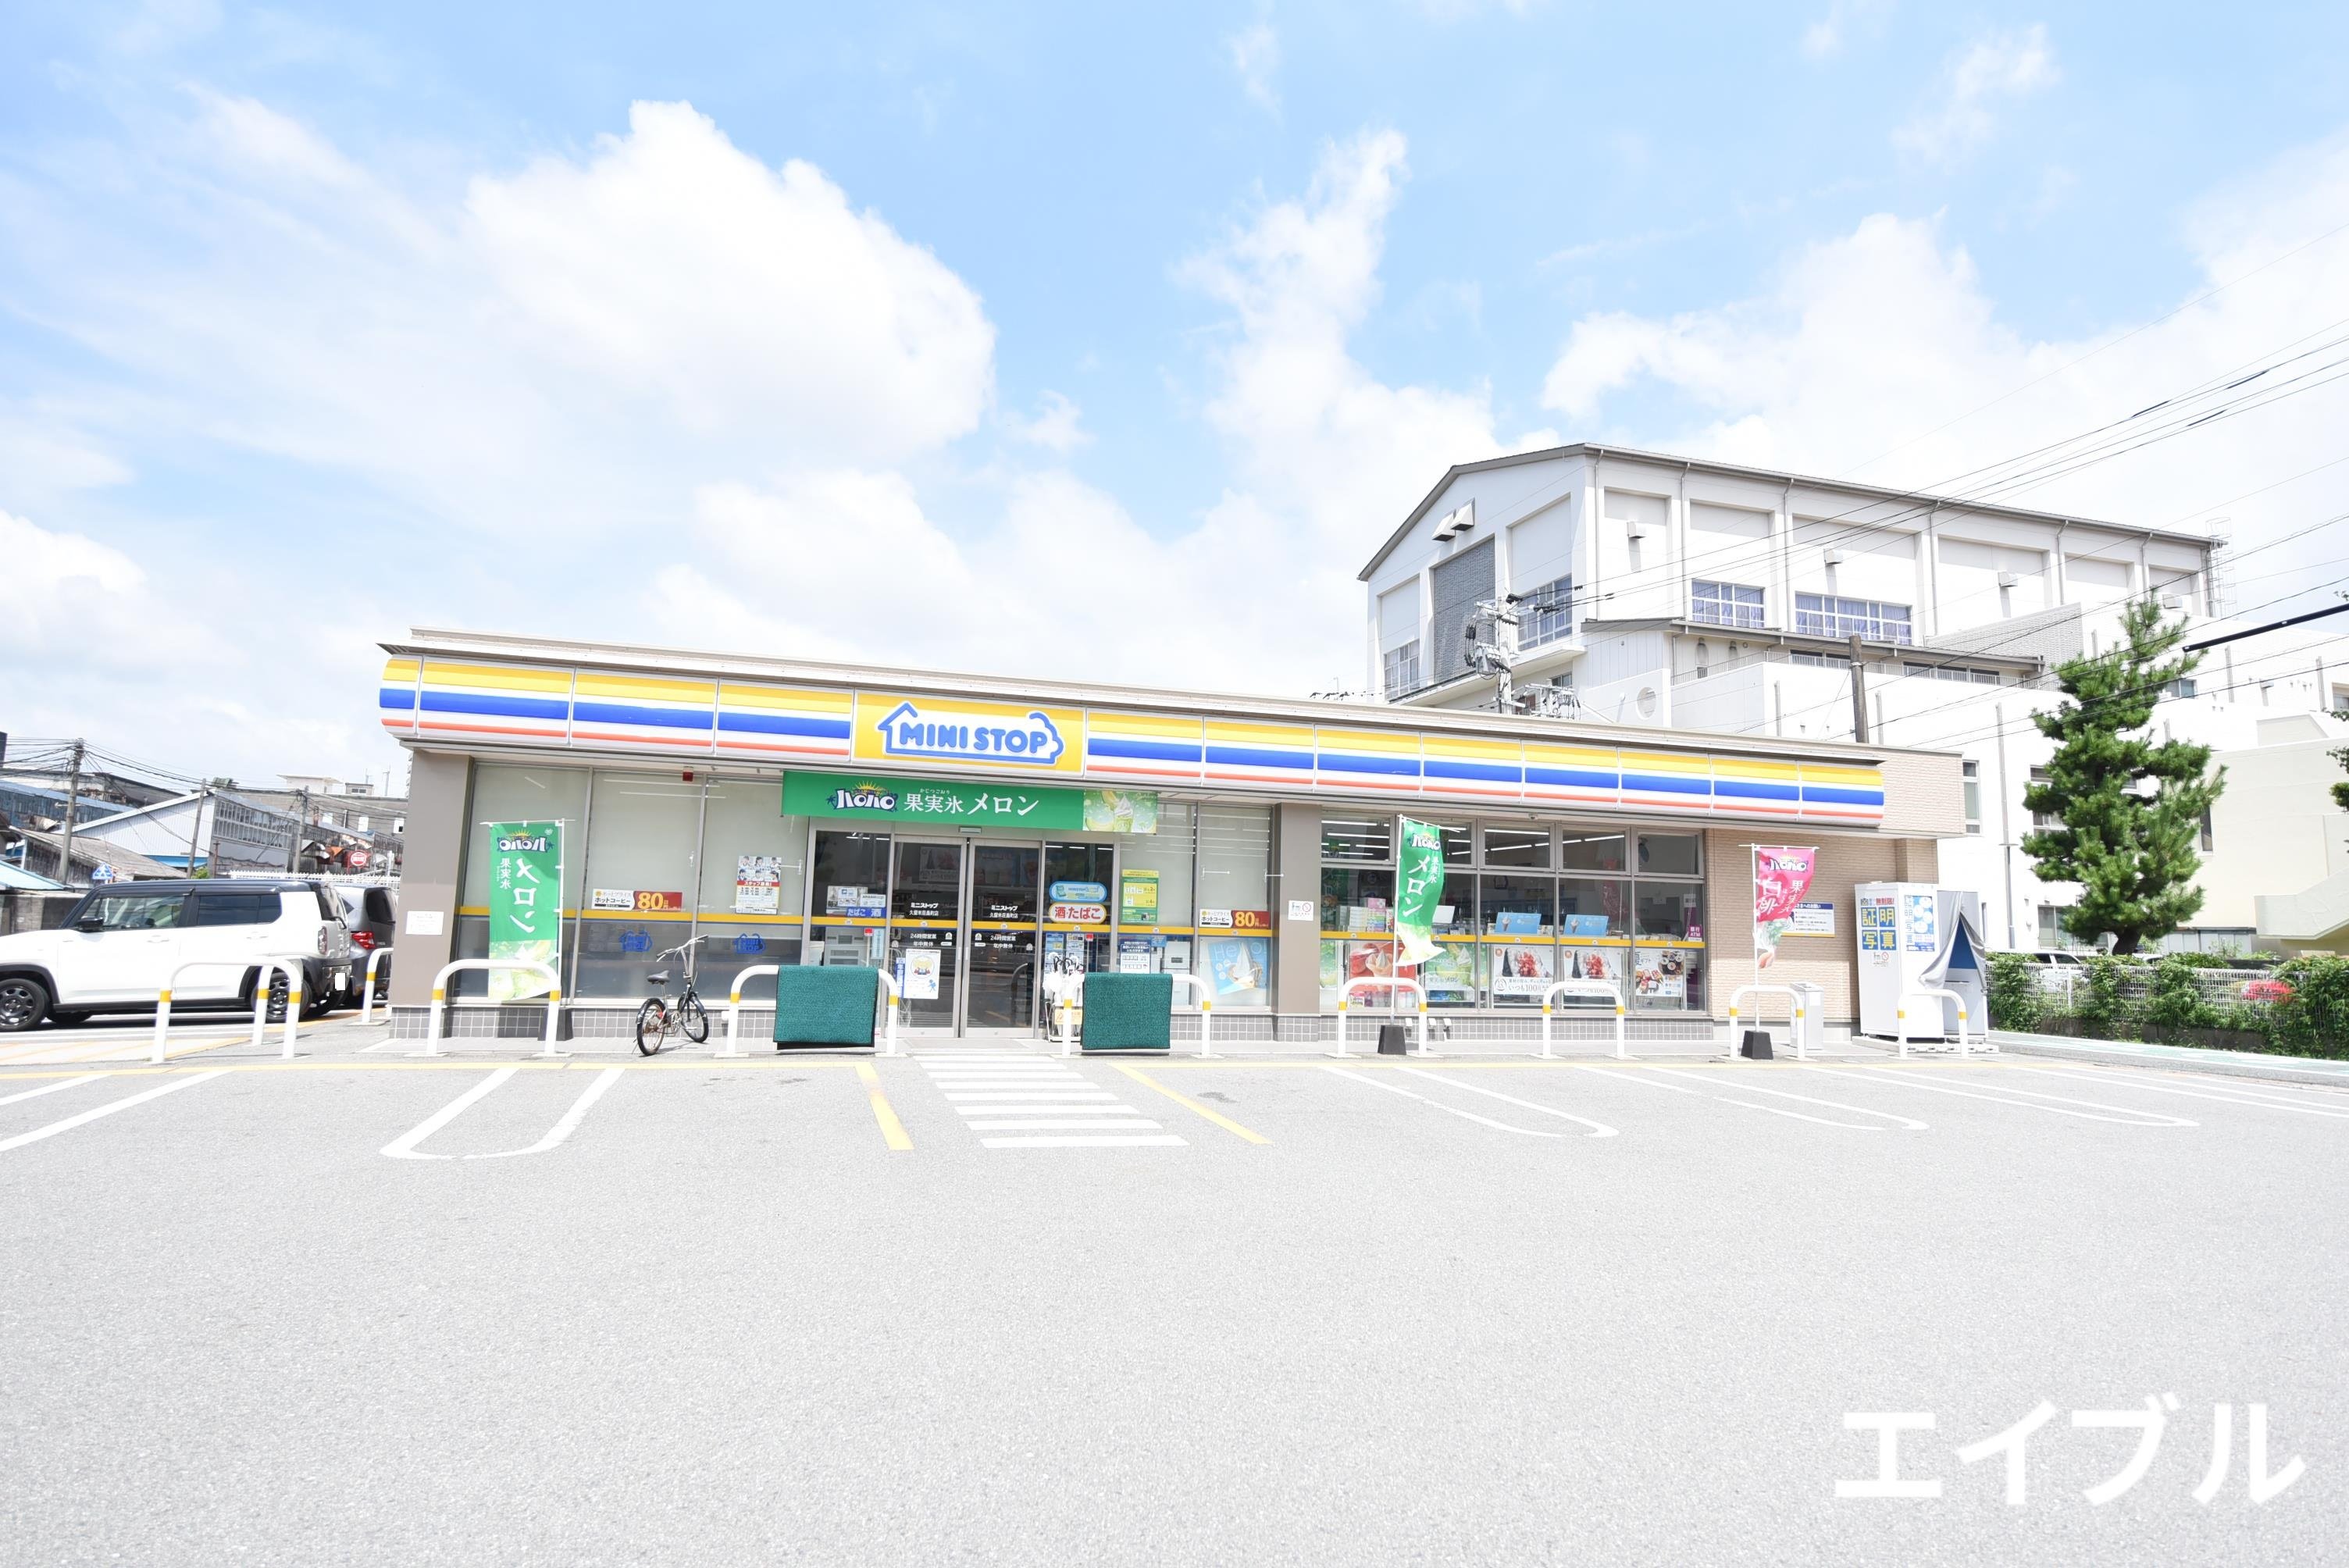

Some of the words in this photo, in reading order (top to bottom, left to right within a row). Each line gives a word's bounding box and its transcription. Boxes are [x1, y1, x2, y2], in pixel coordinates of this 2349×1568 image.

[900, 722, 968, 749] MINI
[973, 727, 1048, 754] STOP
[968, 793, 1039, 816] メロン
[637, 892, 664, 909] 80
[847, 908, 866, 917] たばこ
[1235, 911, 1256, 927] 80
[1862, 908, 1895, 926] 証明
[1862, 932, 1895, 950] 写真
